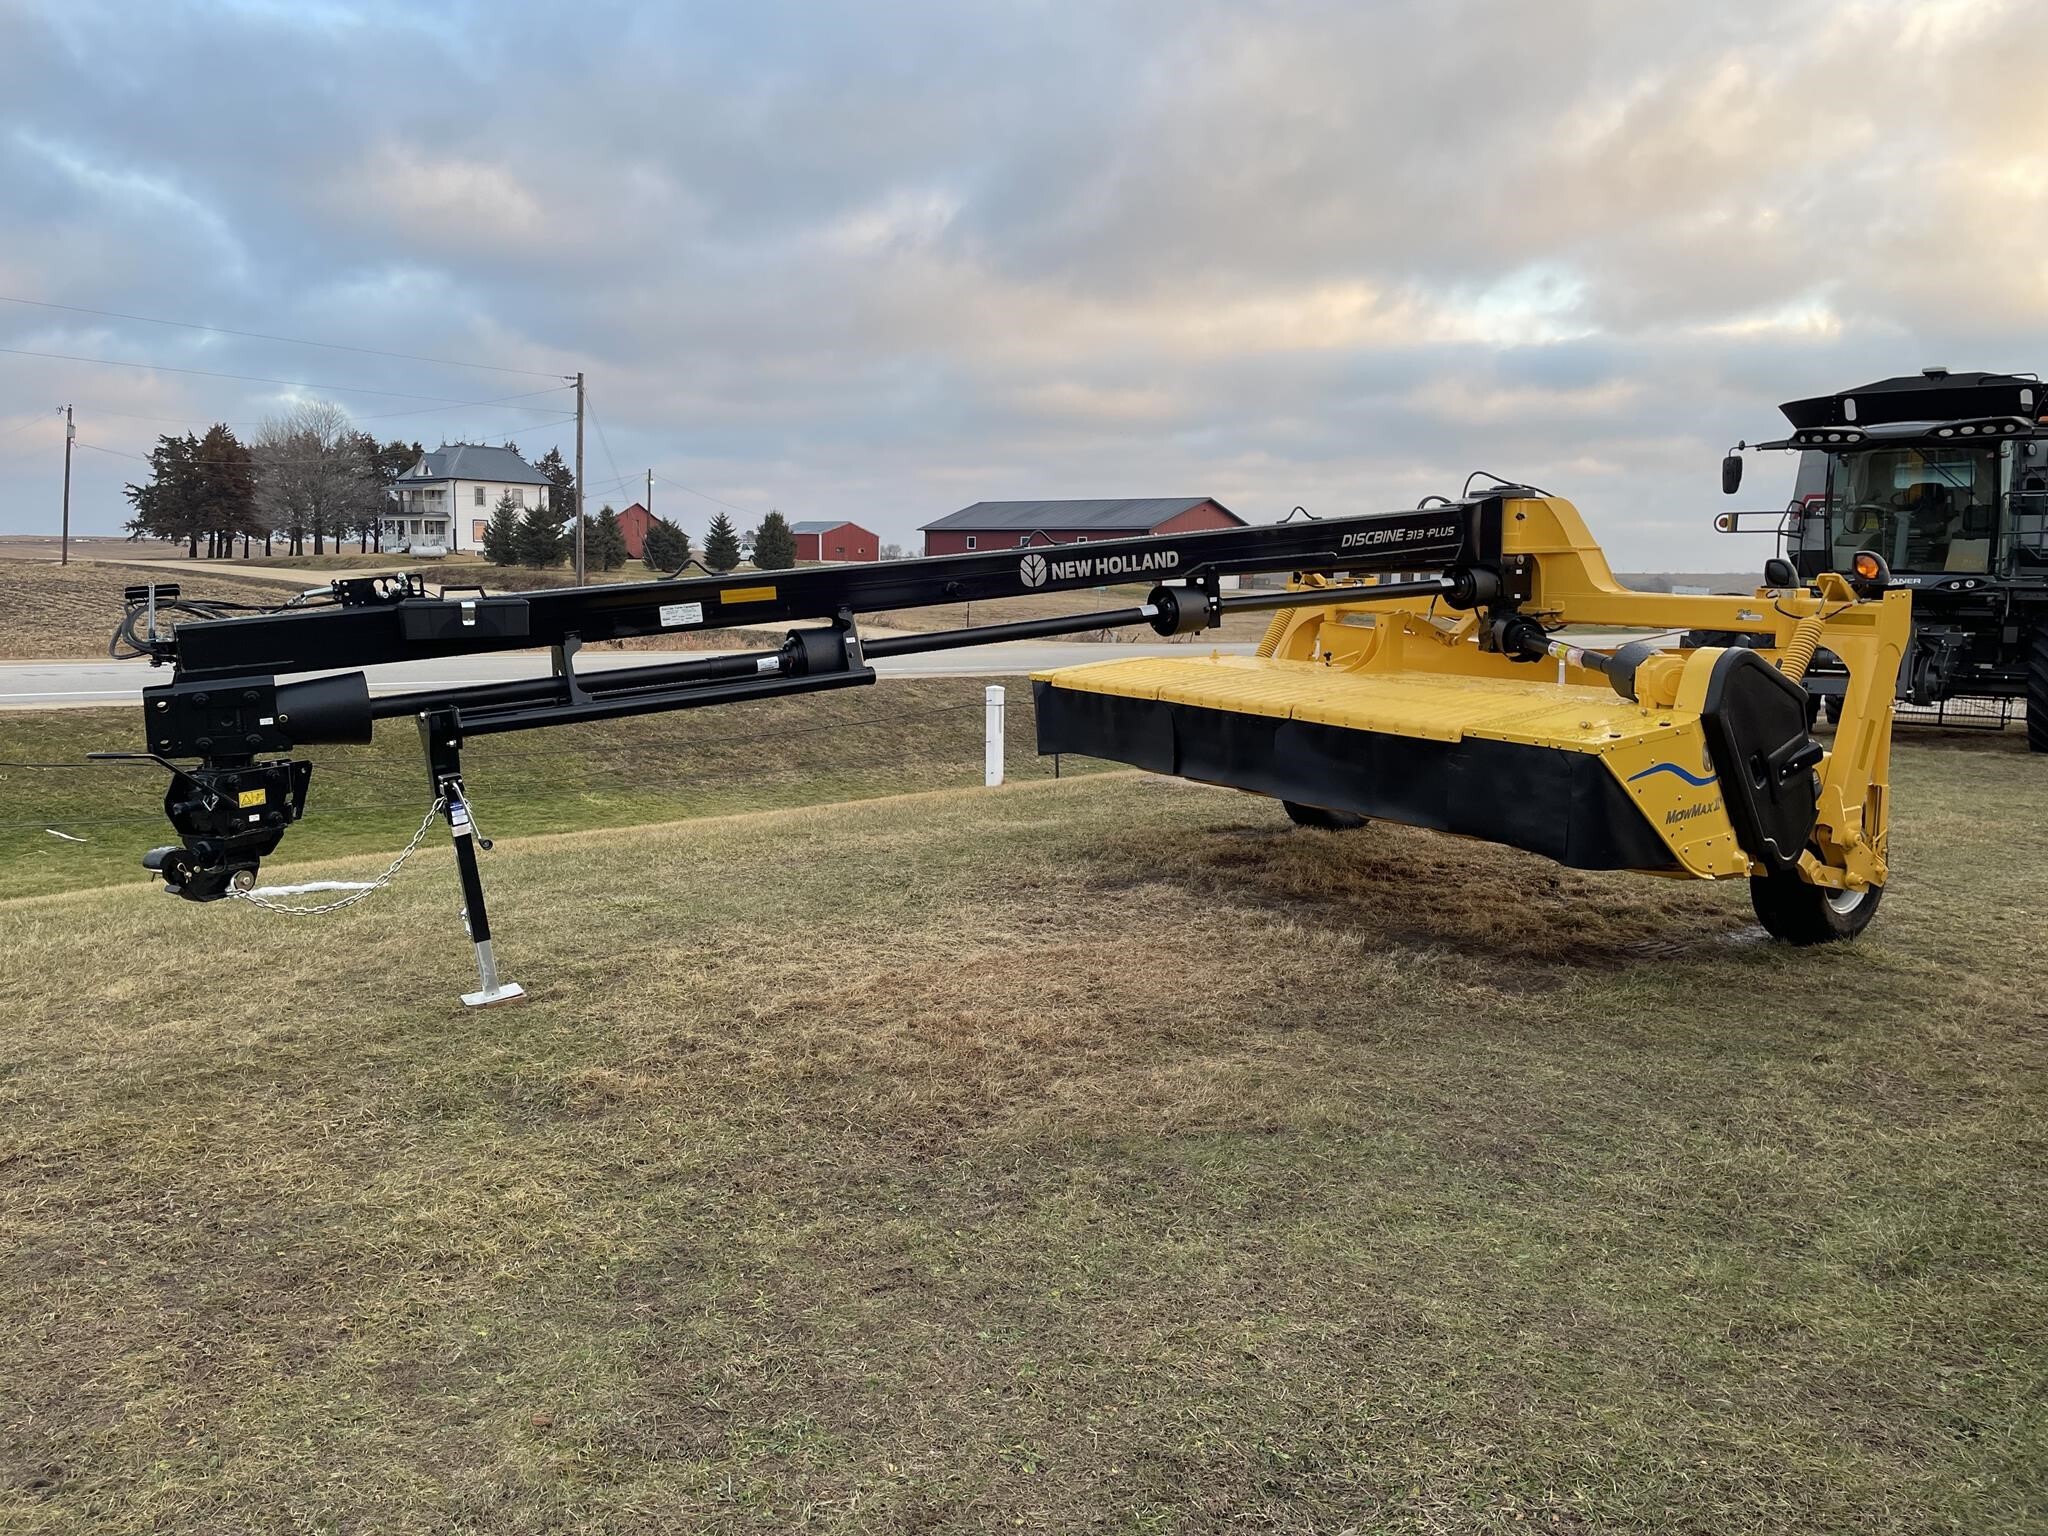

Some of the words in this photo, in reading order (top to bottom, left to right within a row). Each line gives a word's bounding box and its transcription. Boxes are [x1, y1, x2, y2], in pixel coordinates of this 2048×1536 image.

[1341, 528, 1406, 548] DISCBINE
[1406, 529, 1425, 541] 313
[1052, 559, 1092, 581] NEW
[1096, 551, 1179, 576] HOLLAND
